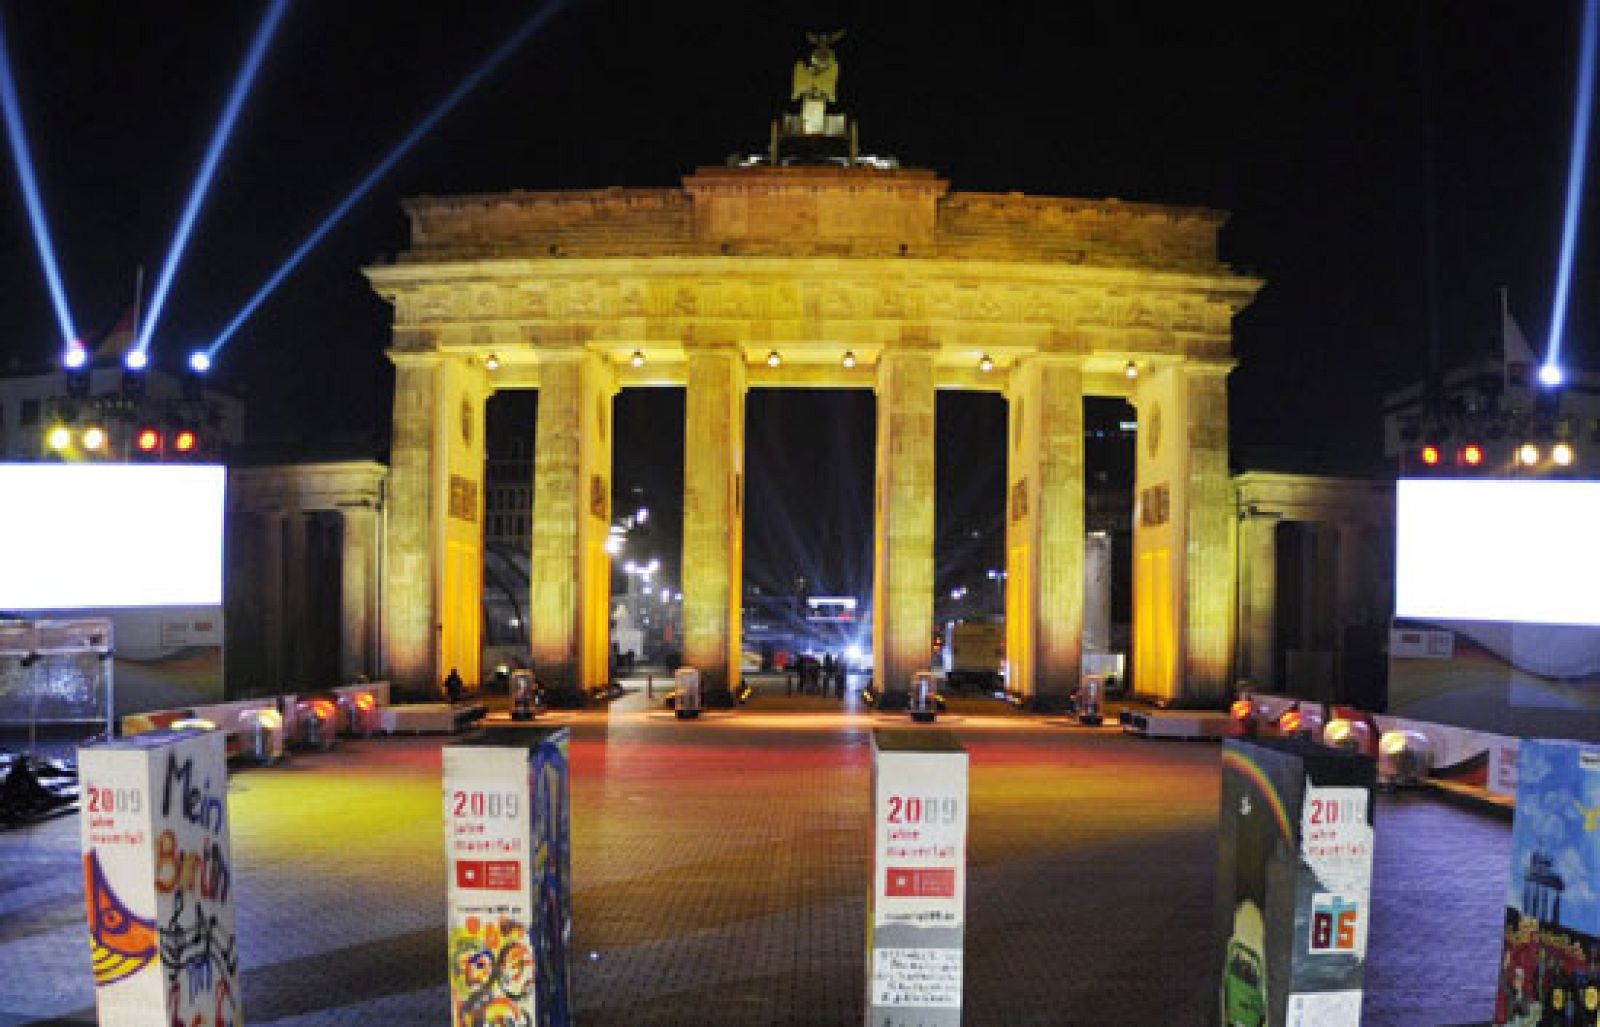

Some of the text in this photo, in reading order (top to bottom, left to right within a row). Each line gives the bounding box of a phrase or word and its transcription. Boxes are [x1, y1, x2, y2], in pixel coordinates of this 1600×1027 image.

[87, 787, 141, 813] 2009
[453, 791, 519, 818] 2009
[886, 797, 957, 824] 2009
